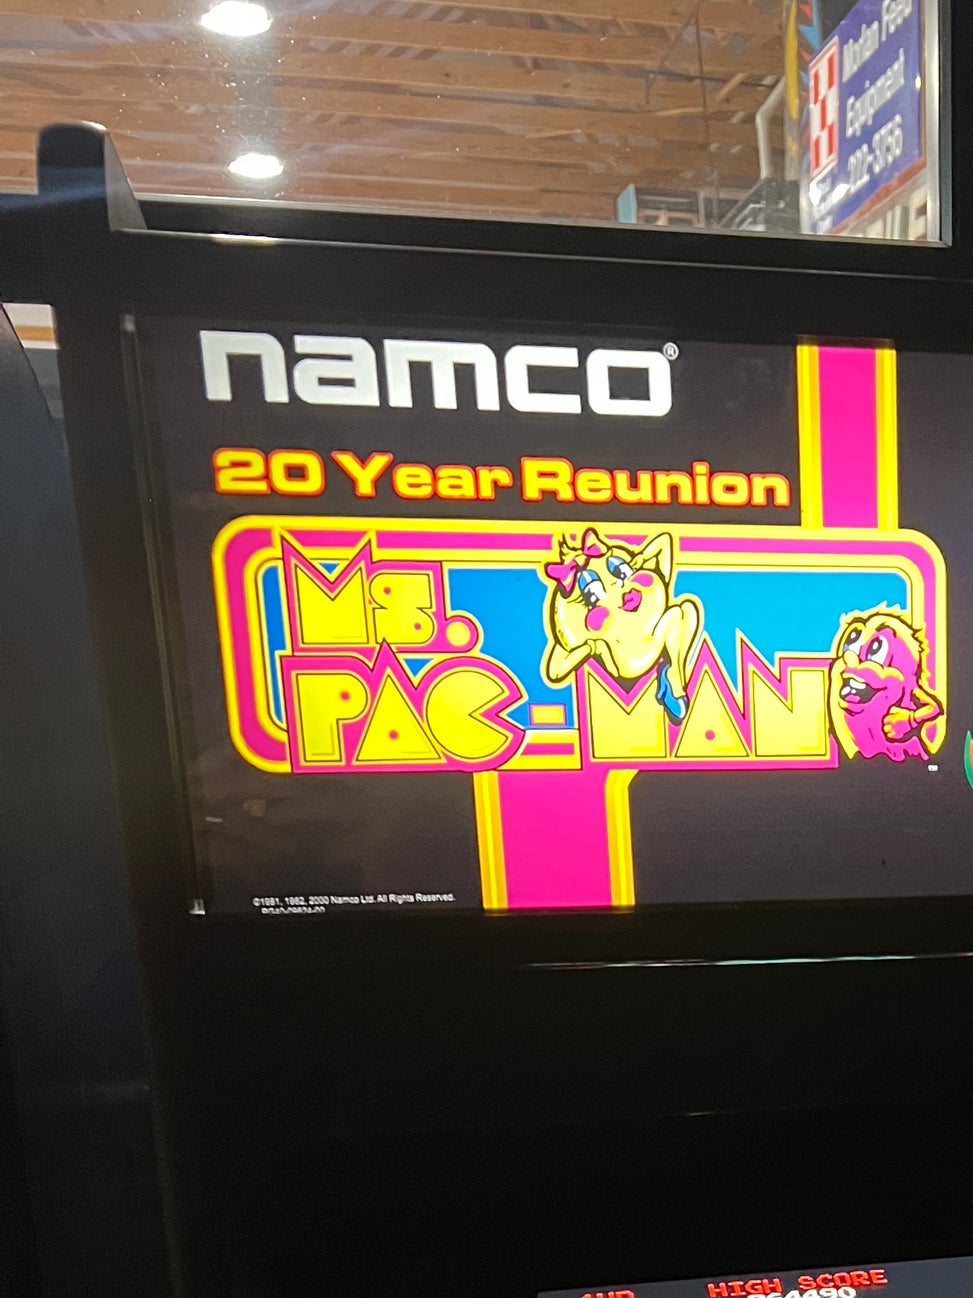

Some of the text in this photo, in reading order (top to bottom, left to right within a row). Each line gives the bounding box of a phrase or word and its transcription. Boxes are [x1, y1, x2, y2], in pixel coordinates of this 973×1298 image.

[212, 447, 791, 508] 20 Year Reunion
[308, 895, 330, 905] 2000
[330, 895, 360, 905] Namco
[377, 894, 388, 903] All
[389, 893, 415, 905] Rights
[415, 892, 456, 903] Reserved.
[798, 1268, 889, 1292] SCORE
